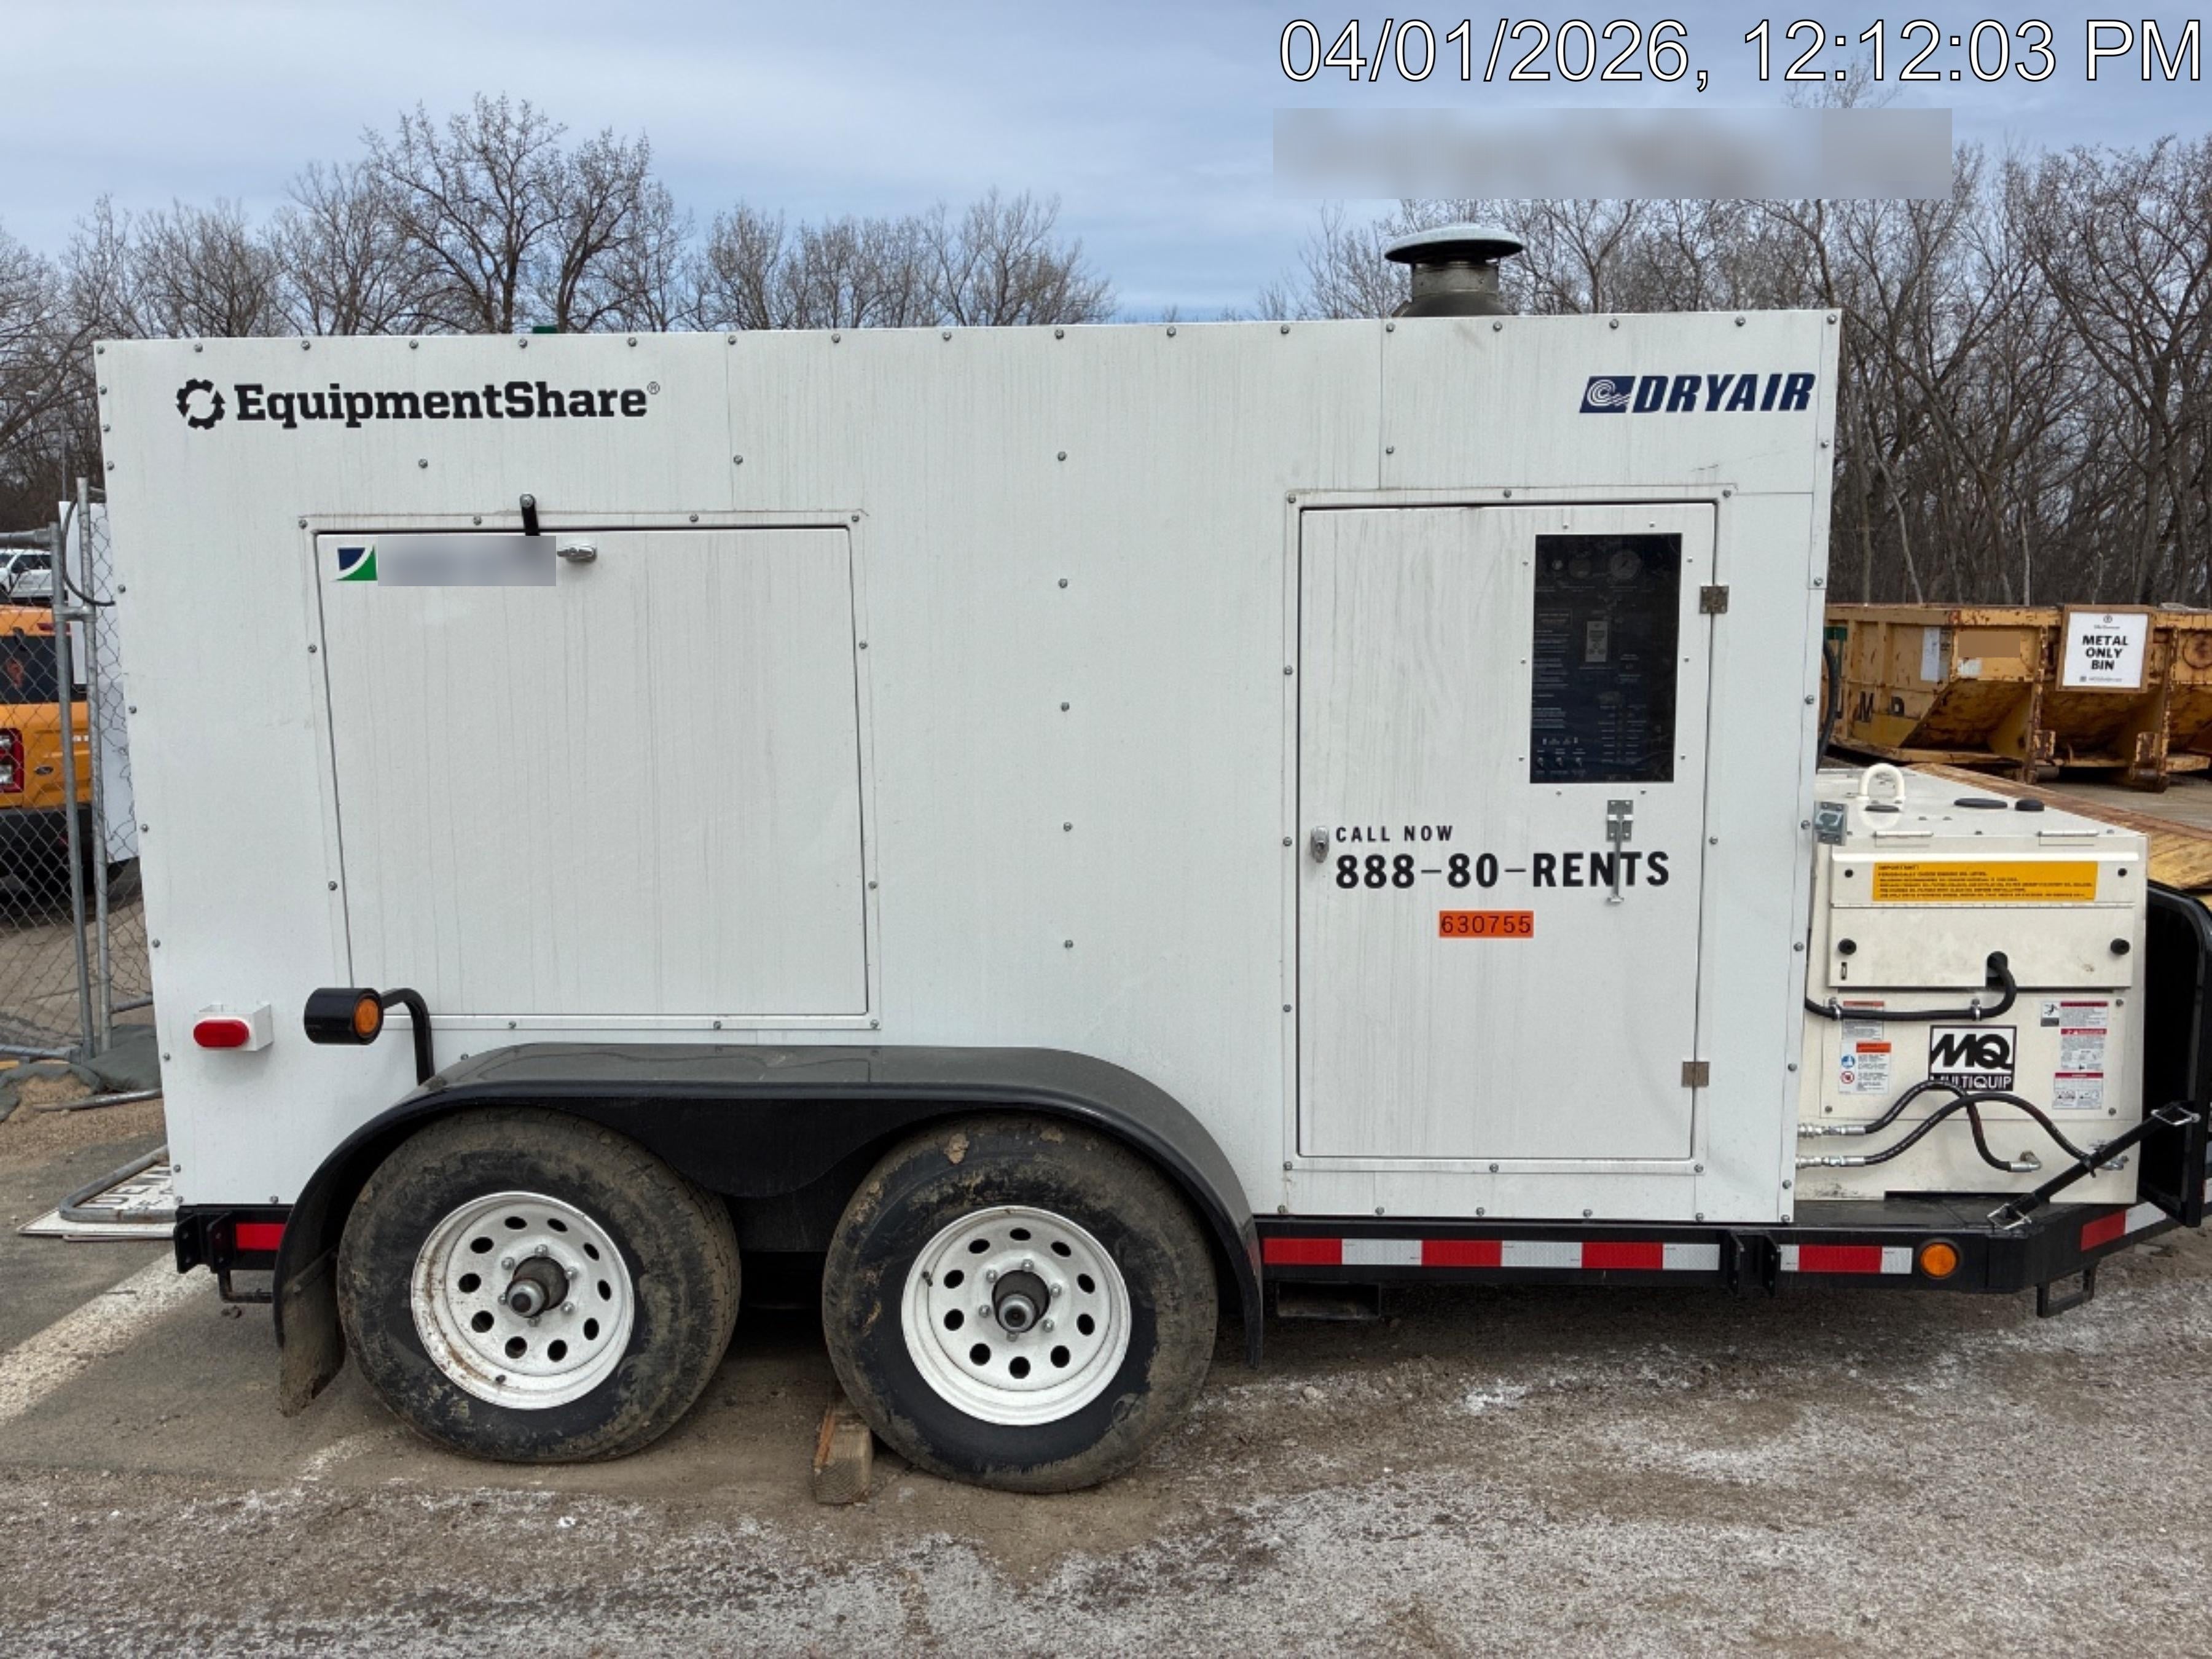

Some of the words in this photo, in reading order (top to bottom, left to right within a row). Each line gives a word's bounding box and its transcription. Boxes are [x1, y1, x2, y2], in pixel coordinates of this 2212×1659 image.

[1631, 372, 1816, 414] DRYAIR
[2082, 635, 2128, 646] METAL
[2085, 647, 2123, 659] ONLY
[2091, 659, 2115, 670] BIN
[1336, 826, 1390, 842] CALL
[1404, 825, 1453, 842] NOW
[1336, 851, 1669, 889] 888-80-RENTS
[1441, 915, 1531, 934] 630755
[1931, 1033, 2014, 1070] MQ
